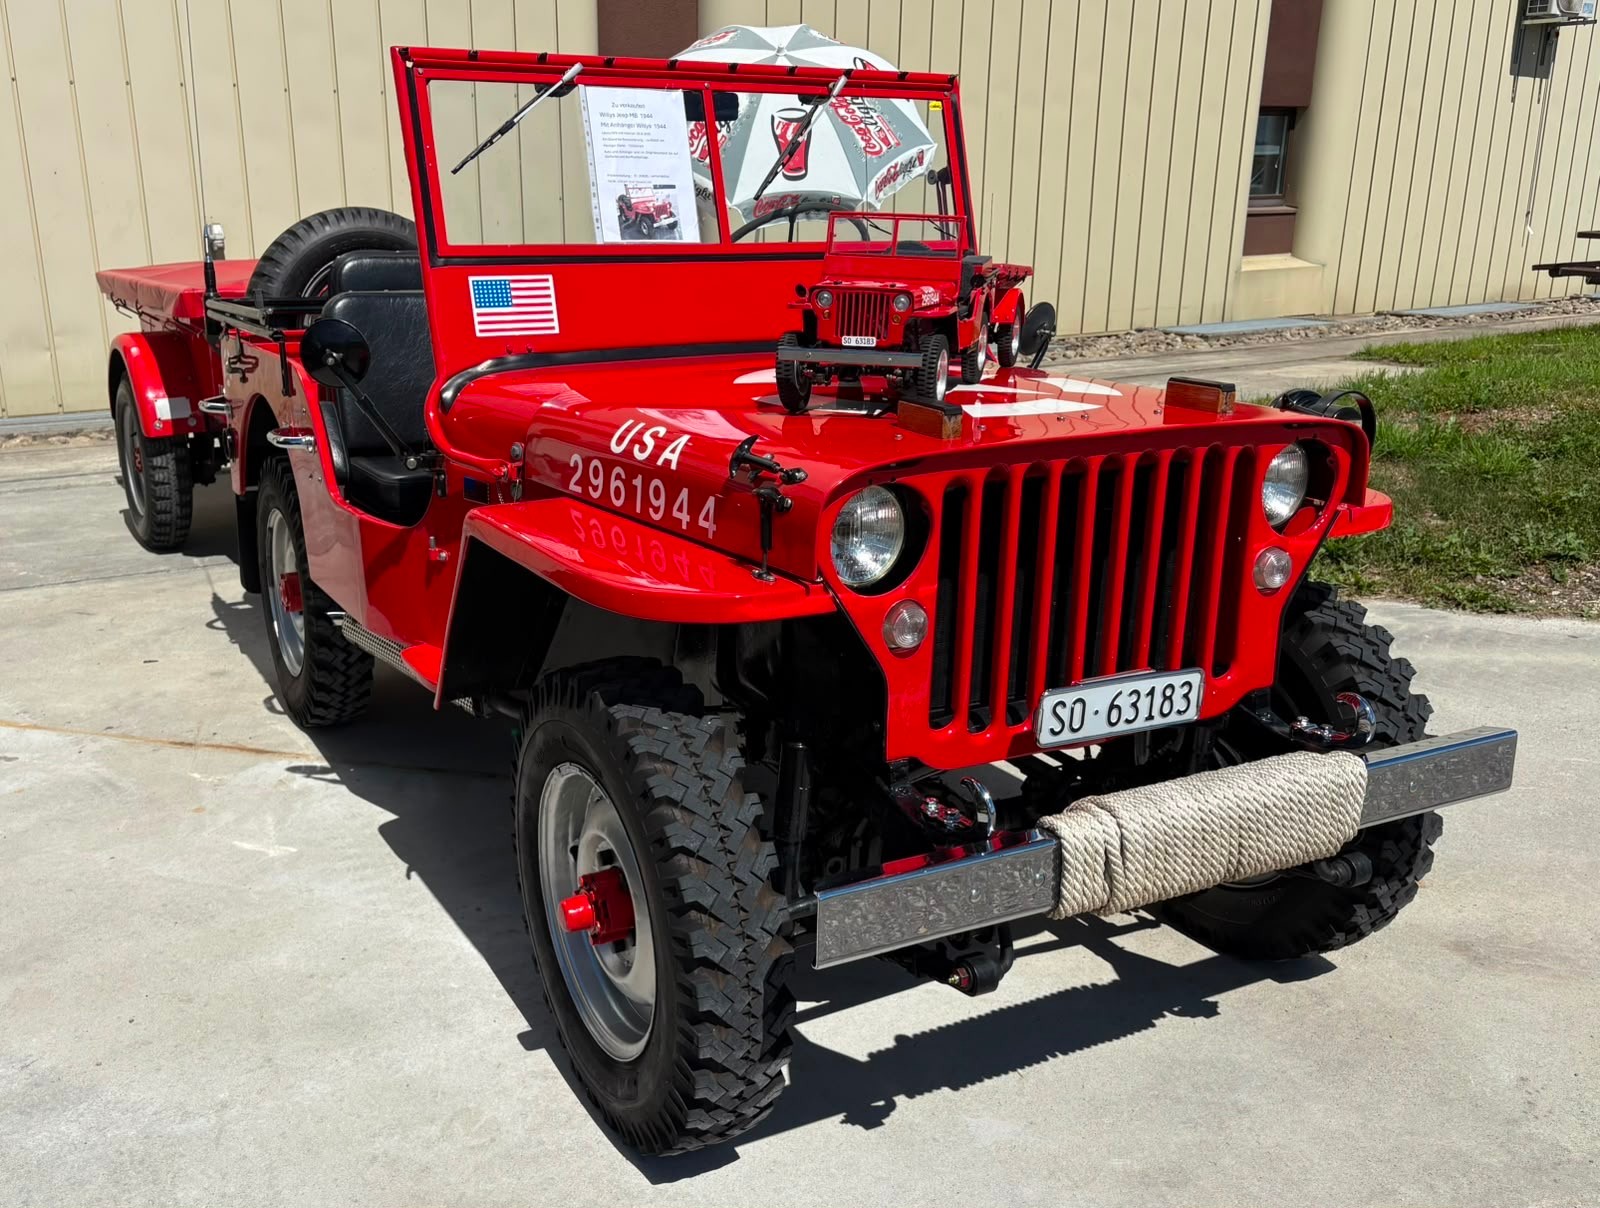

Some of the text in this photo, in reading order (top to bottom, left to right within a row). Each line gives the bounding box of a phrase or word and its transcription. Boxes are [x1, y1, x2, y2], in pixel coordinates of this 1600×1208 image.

[843, 337, 875, 345] SO 63183
[610, 419, 692, 471] USA
[568, 453, 717, 540] 2961944
[1049, 680, 1193, 736] SO 63183
